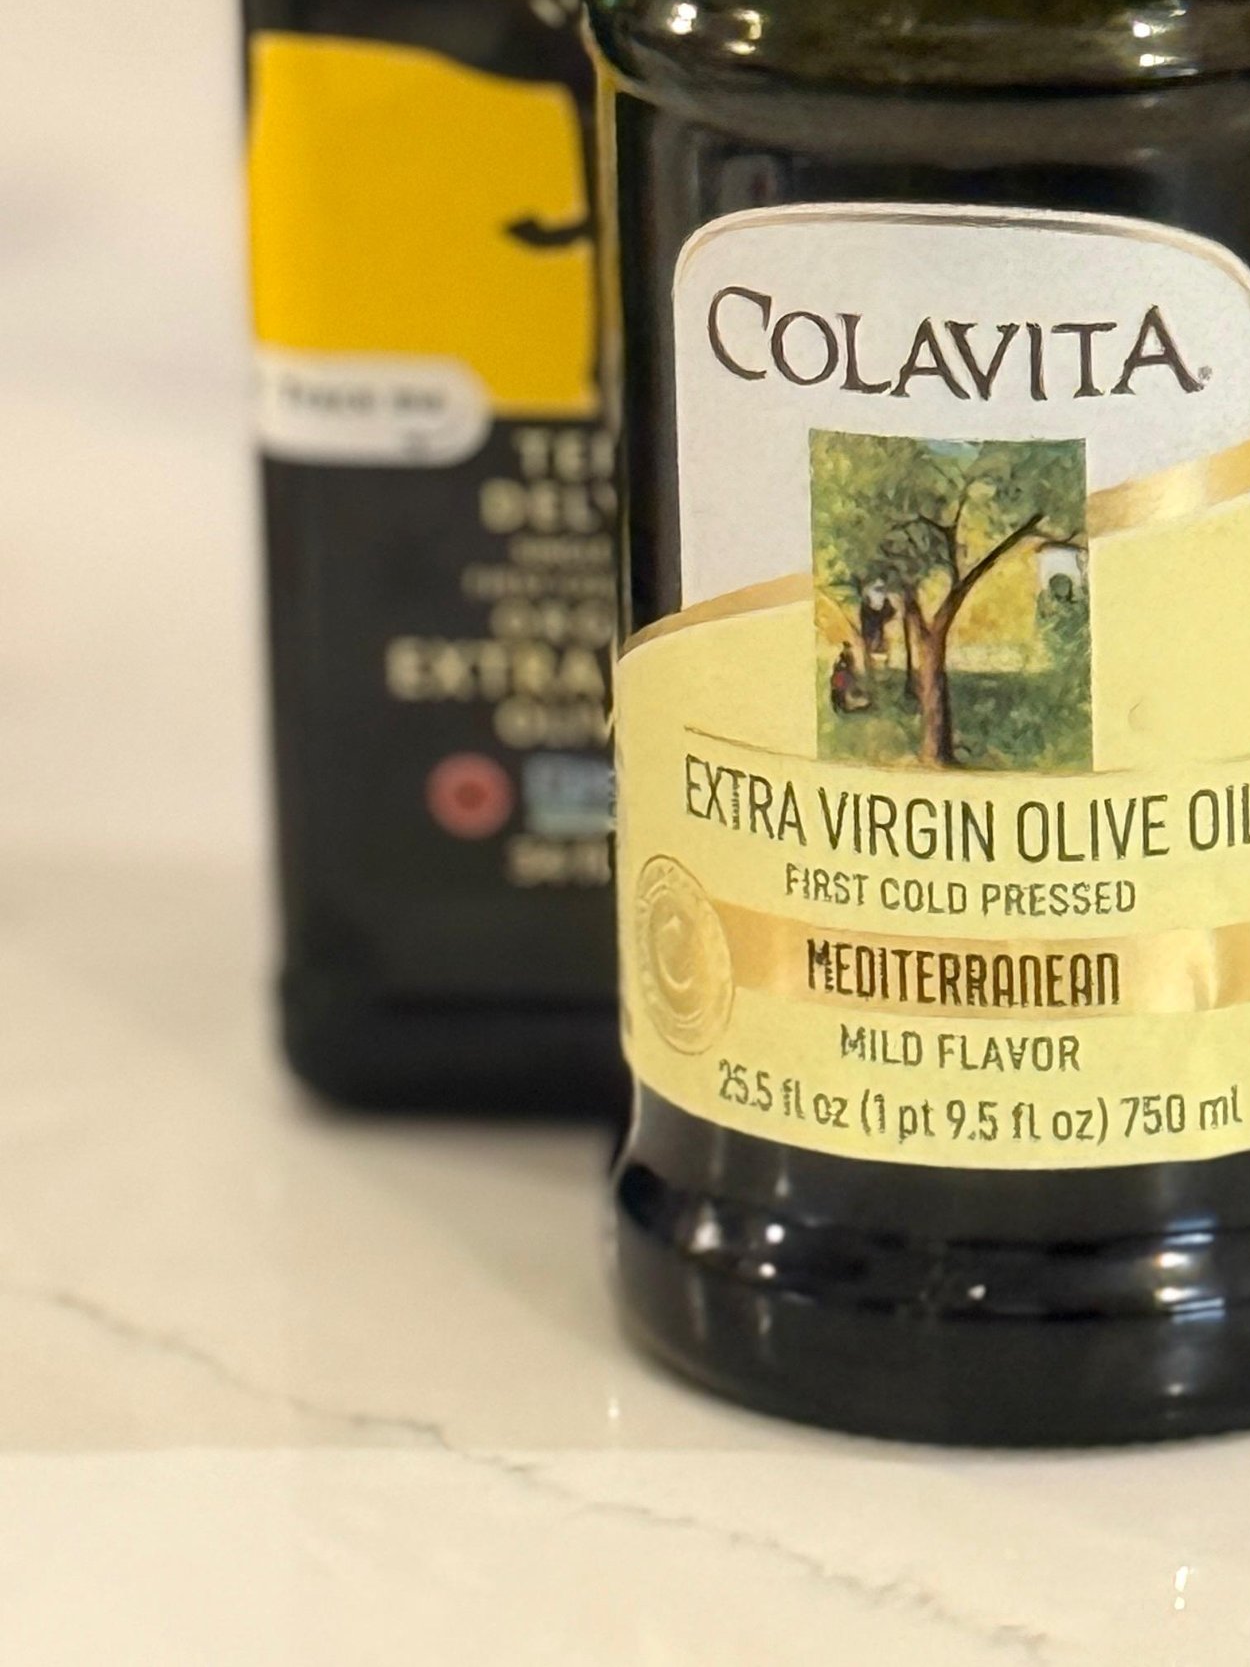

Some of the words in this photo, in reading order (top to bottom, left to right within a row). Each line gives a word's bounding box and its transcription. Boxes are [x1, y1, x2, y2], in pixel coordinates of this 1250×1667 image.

[707, 286, 1206, 402] COLAVITA
[385, 635, 607, 702] EXTRA
[684, 753, 808, 847] EXTRA
[817, 785, 996, 864] VIRGIN
[1016, 793, 1170, 863] OLIVE
[785, 862, 868, 907] FIRST
[880, 878, 967, 915] COLD
[981, 879, 1136, 916] PRESSED
[806, 938, 1121, 1009] MEDITERRANEAN
[840, 1023, 923, 1068] MILD
[938, 1035, 1081, 1073] FLAVOR
[717, 1058, 773, 1113] 25.5
[780, 1076, 804, 1121] fl
[813, 1093, 850, 1130] oz
[860, 1087, 887, 1137] (1
[897, 1096, 935, 1144] pt
[945, 1100, 999, 1141] 9.5
[1013, 1101, 1041, 1140] fl
[1051, 1097, 1109, 1147] oz)
[1120, 1093, 1186, 1139] 750
[1199, 1084, 1243, 1131] ml
